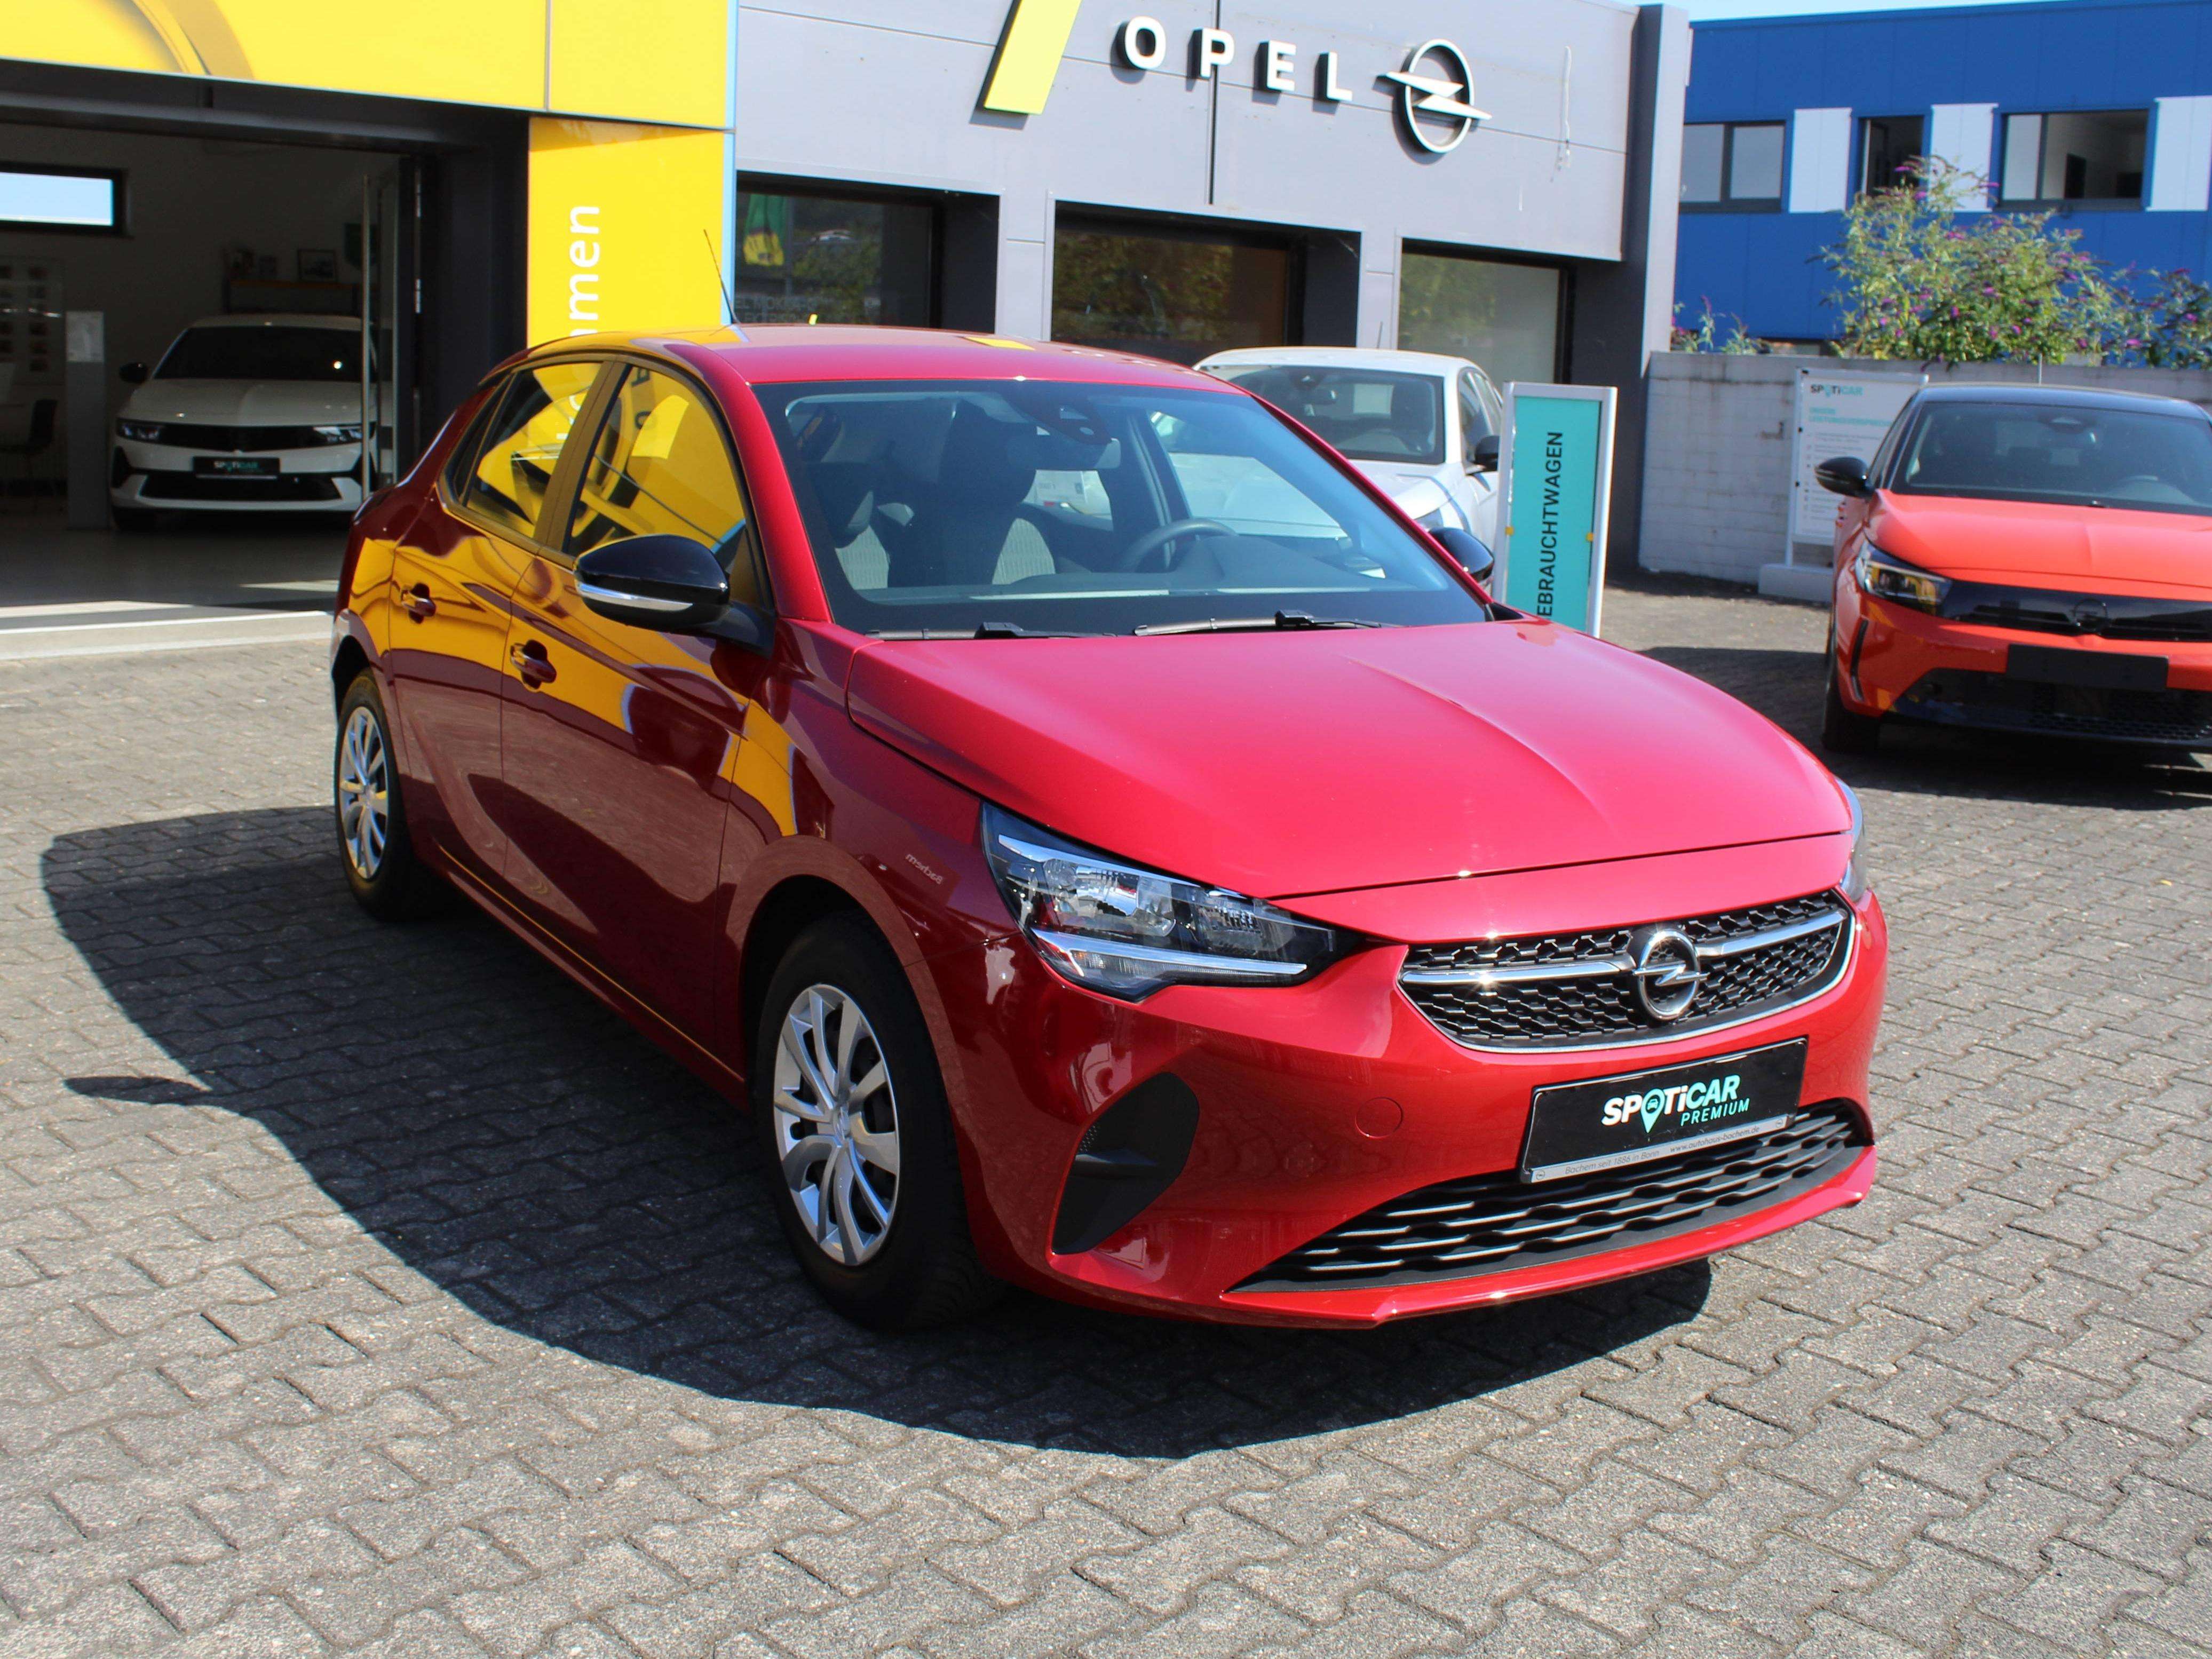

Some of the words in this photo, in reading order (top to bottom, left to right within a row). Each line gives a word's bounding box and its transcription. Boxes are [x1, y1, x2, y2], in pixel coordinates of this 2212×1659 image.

[1121, 15, 1353, 102] OPEL
[568, 205, 600, 337] men
[1537, 431, 1563, 617] EBRAUCHTWAGEN
[1670, 1125, 1760, 1153] www.autohaus-bachem.de
[1680, 1097, 1750, 1127] PREMIUM
[1564, 1163, 1596, 1174] Bachem
[1597, 1160, 1611, 1169] seit
[1614, 1155, 1631, 1165] 1886
[1640, 1150, 1660, 1160] Bonn
